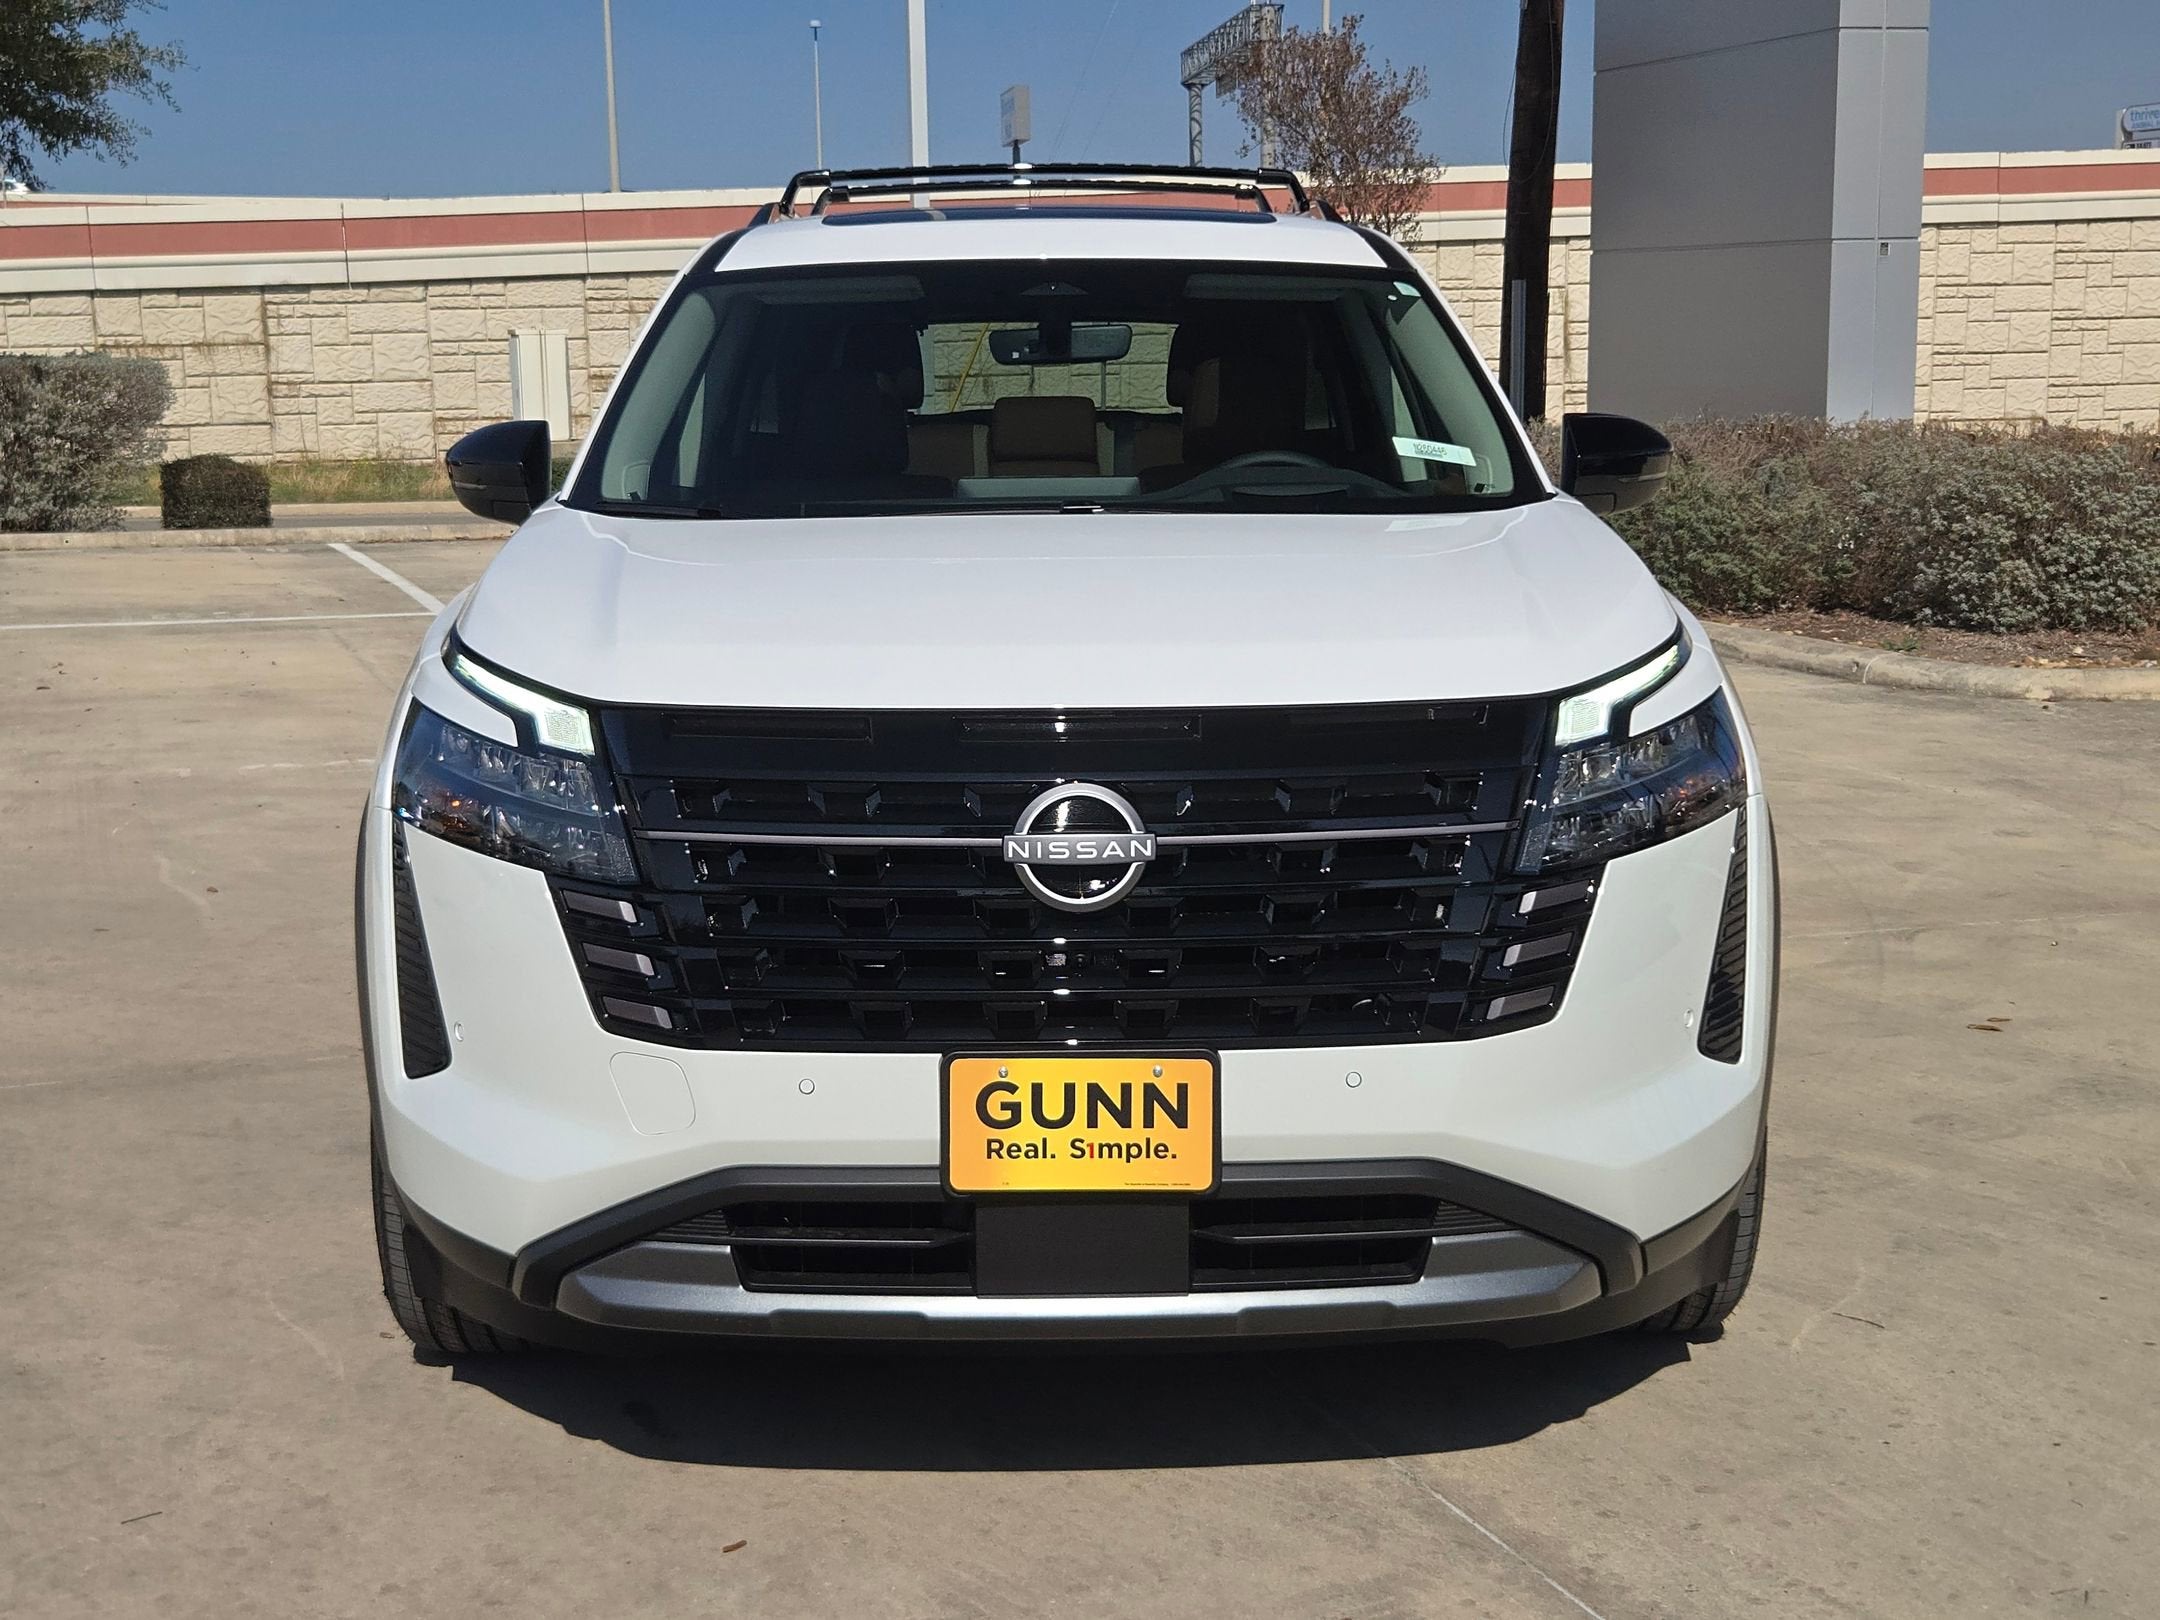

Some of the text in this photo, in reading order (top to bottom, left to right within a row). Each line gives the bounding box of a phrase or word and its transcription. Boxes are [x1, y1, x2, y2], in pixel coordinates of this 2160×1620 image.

[1008, 840, 1152, 859] NISSAN
[975, 1081, 1189, 1130] GUNN
[987, 1137, 1056, 1159] Real.
